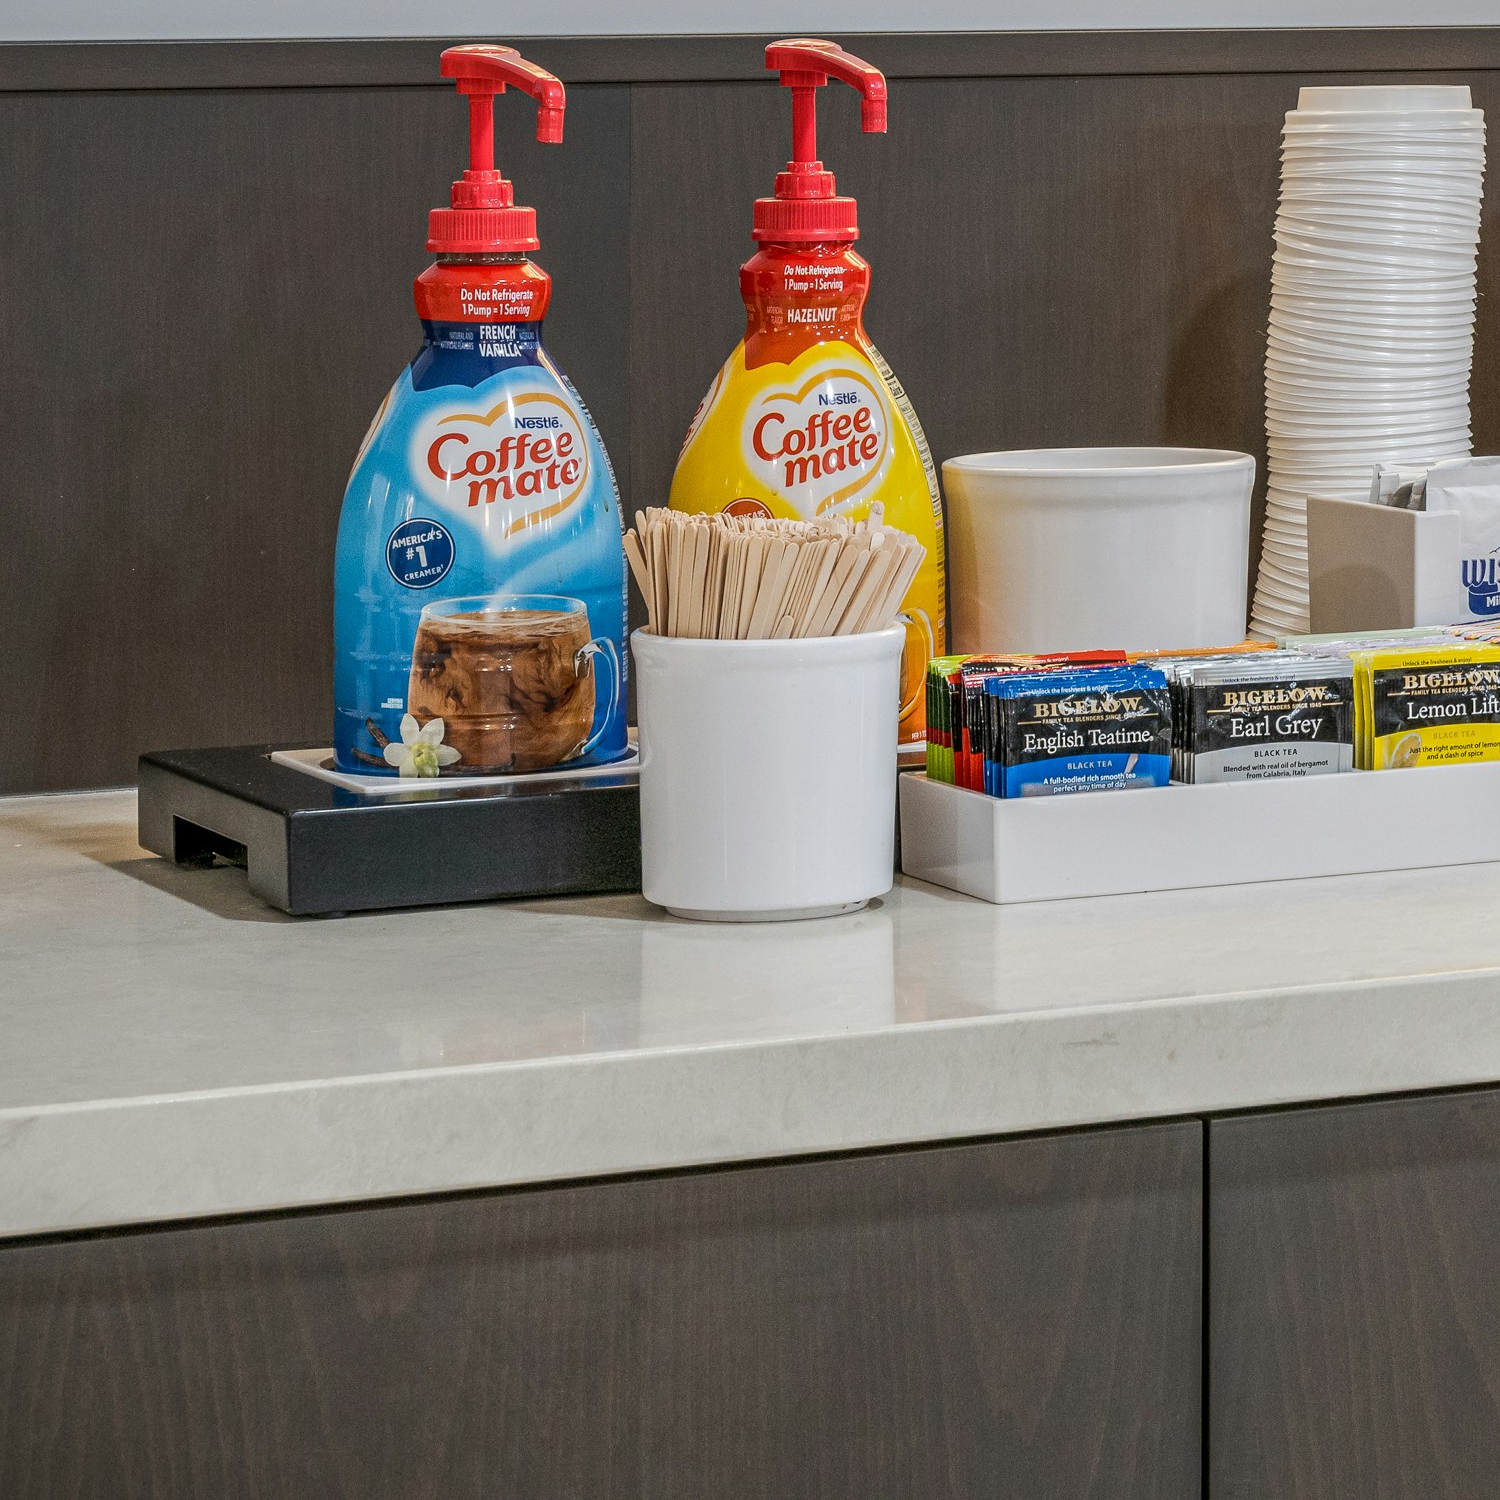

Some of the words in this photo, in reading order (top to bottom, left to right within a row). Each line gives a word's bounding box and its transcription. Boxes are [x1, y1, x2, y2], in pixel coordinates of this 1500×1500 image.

[784, 265, 793, 275] Do
[795, 265, 809, 275] Not
[784, 279, 788, 290] 1
[789, 279, 808, 292] Pump
[819, 279, 843, 292] Serving
[461, 289, 472, 300] Do
[475, 288, 490, 301] Not
[492, 289, 533, 303] Refrigerate
[463, 304, 467, 315] 1
[468, 304, 491, 317] Pump
[499, 304, 503, 315] 1
[505, 303, 530, 317] Serving
[788, 307, 838, 323] HAZELNUT
[479, 325, 516, 340] FRENCH
[479, 343, 522, 357] VANILLA
[752, 406, 871, 461] Coffee
[427, 432, 573, 481] Coffee
[784, 433, 879, 487] mate
[468, 458, 580, 507] mate
[392, 530, 442, 549] AMERICA'S
[1402, 669, 1500, 690] BIGELOW
[1223, 686, 1328, 707] BIGELOW
[1033, 697, 1142, 718] BIGELOW
[1407, 702, 1467, 719] Lemon
[1230, 715, 1270, 738] Earl
[1275, 715, 1323, 739] Grey
[1024, 730, 1084, 754] English
[1433, 732, 1459, 740] BLACK
[1254, 749, 1280, 757] BLACK
[1434, 745, 1448, 753] right
[1449, 743, 1473, 751] amount
[1468, 750, 1483, 758] spice
[1067, 761, 1094, 770] BLACK
[1097, 760, 1113, 768] TEA
[1223, 764, 1251, 773] Blended
[1267, 762, 1280, 770] real
[1297, 759, 1328, 769] bergamot
[1050, 774, 1086, 785] full-bodied
[1087, 774, 1099, 782] rich
[1100, 772, 1125, 781] smooth
[1263, 770, 1291, 778] Calabria,
[1292, 769, 1307, 778] Italy
[1053, 783, 1077, 794] perfect
[1078, 784, 1091, 792] any
[1091, 782, 1105, 790] time
[1114, 780, 1127, 790] day
